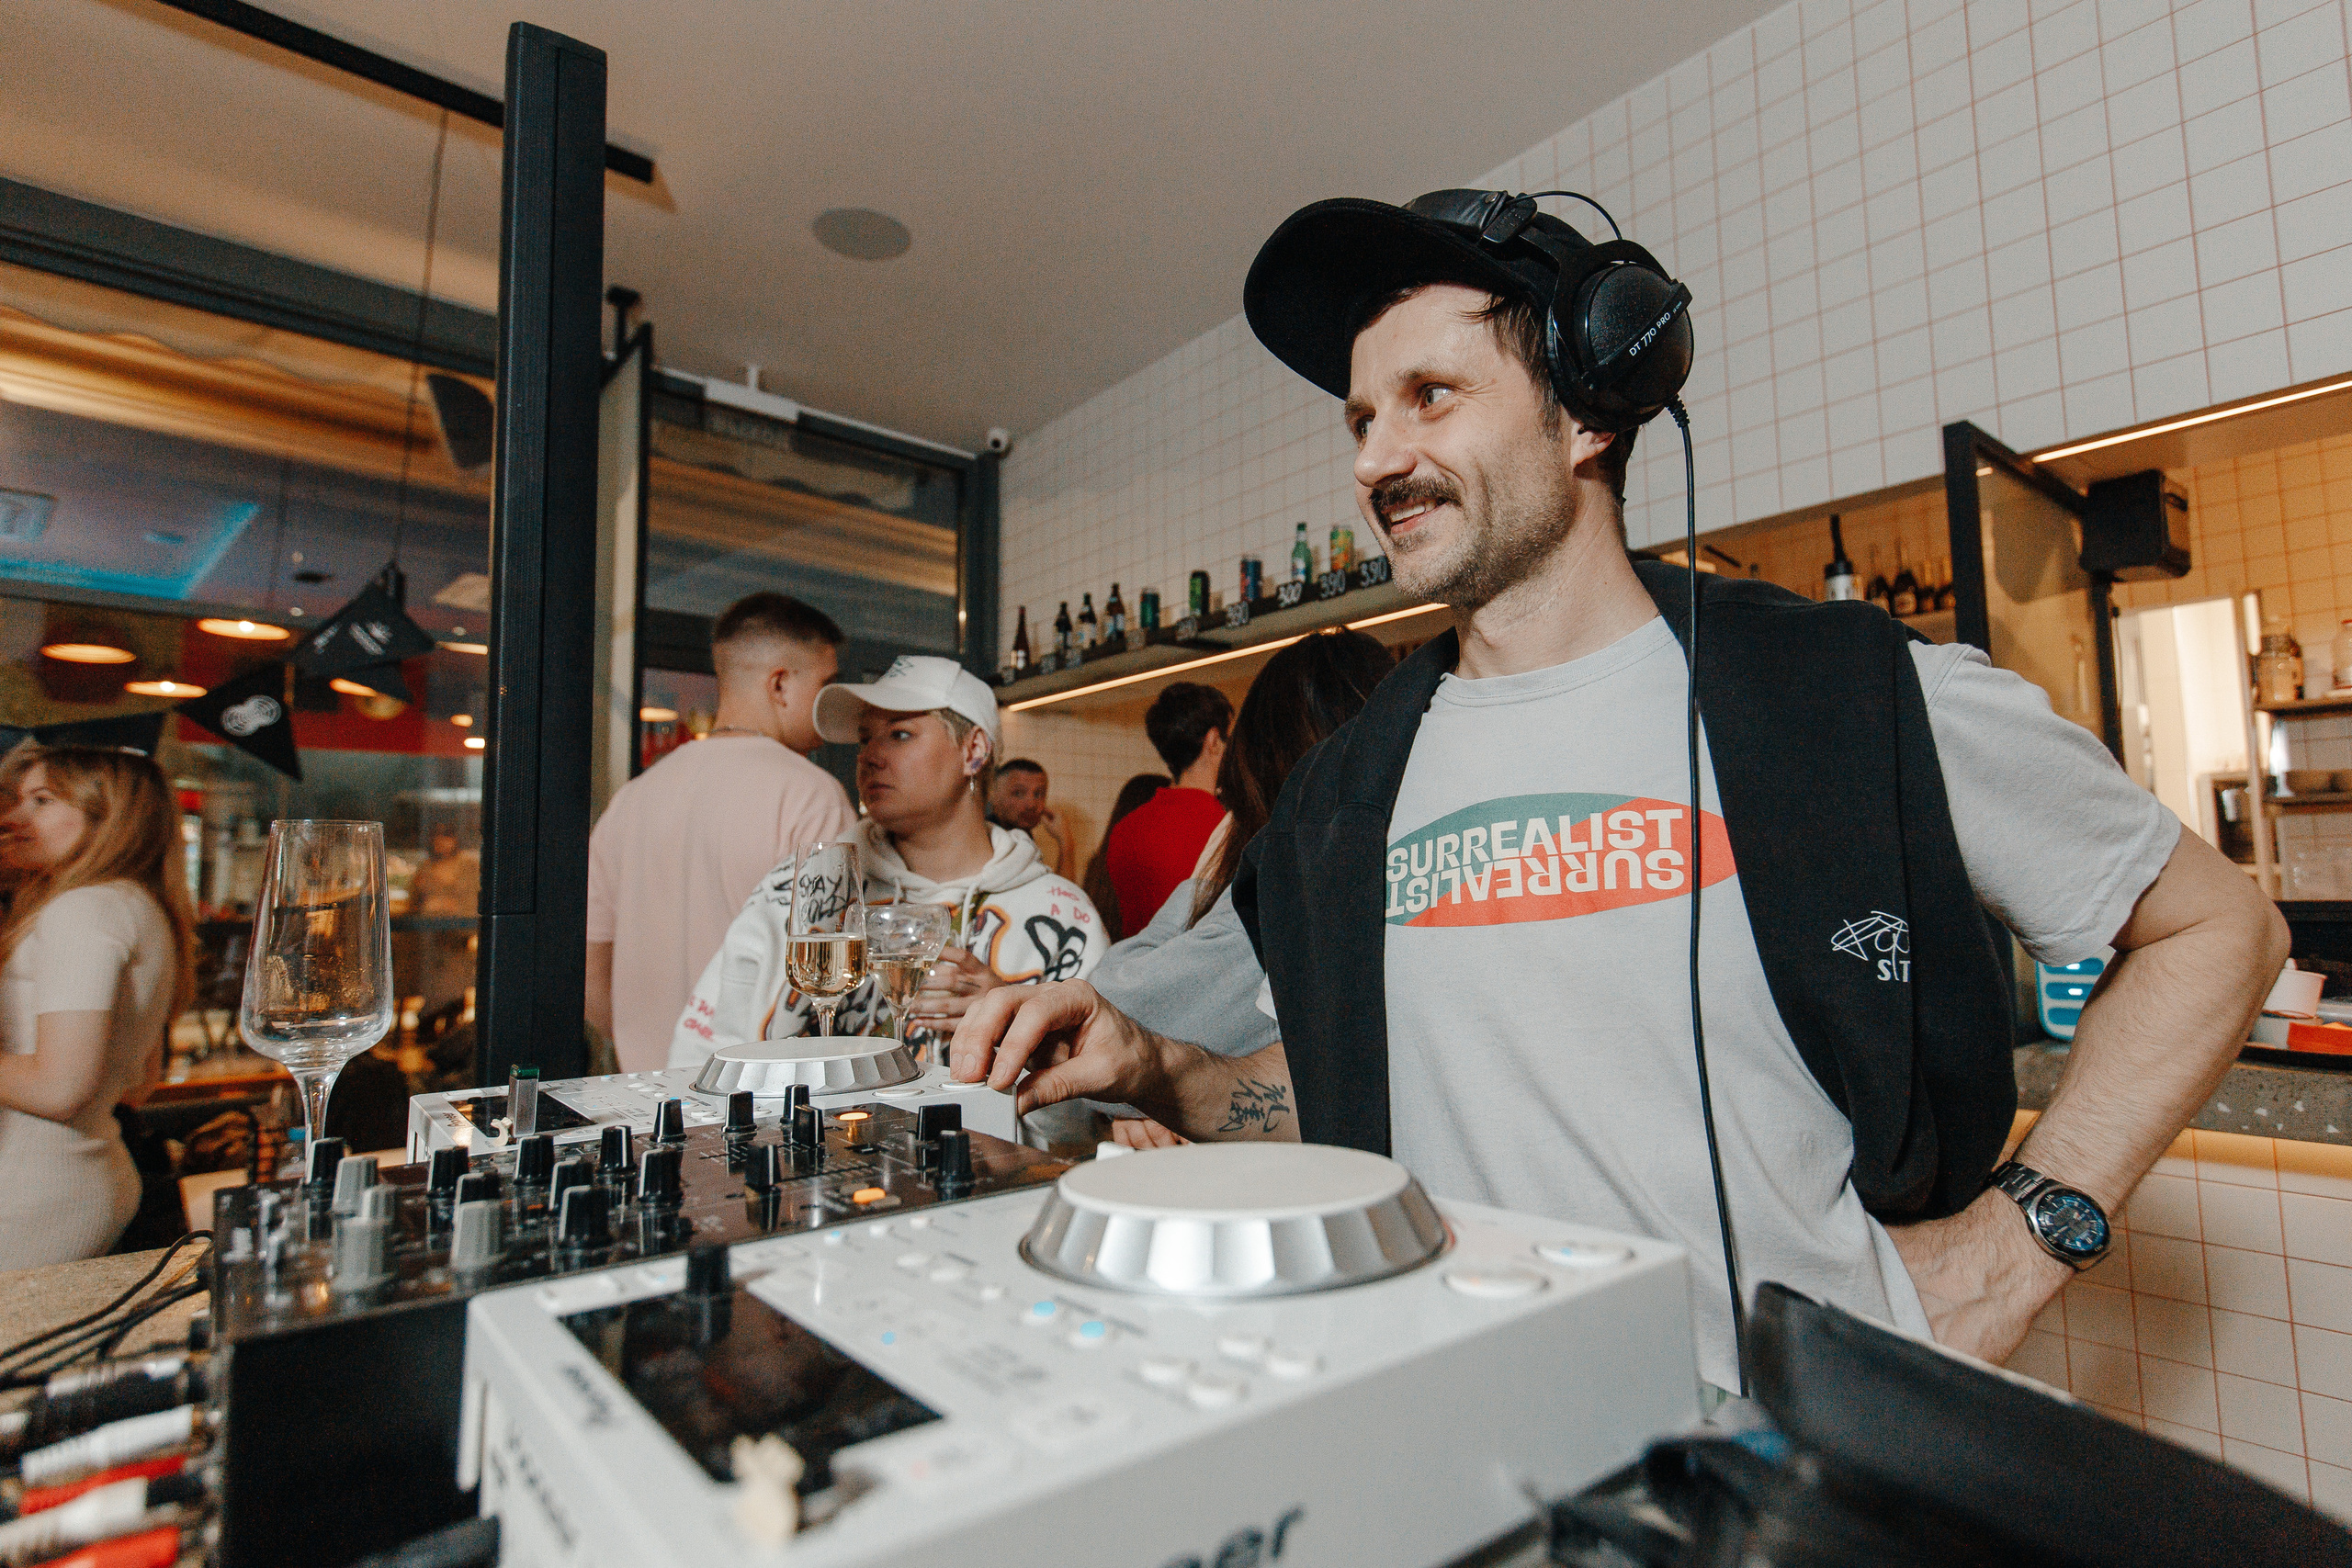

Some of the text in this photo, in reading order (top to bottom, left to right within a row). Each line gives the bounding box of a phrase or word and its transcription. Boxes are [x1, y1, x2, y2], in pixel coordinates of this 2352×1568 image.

[1628, 312, 1671, 356] DT 770 PRO
[1385, 808, 1683, 884] SURREALIST
[1385, 849, 1685, 918] SURREALIST
